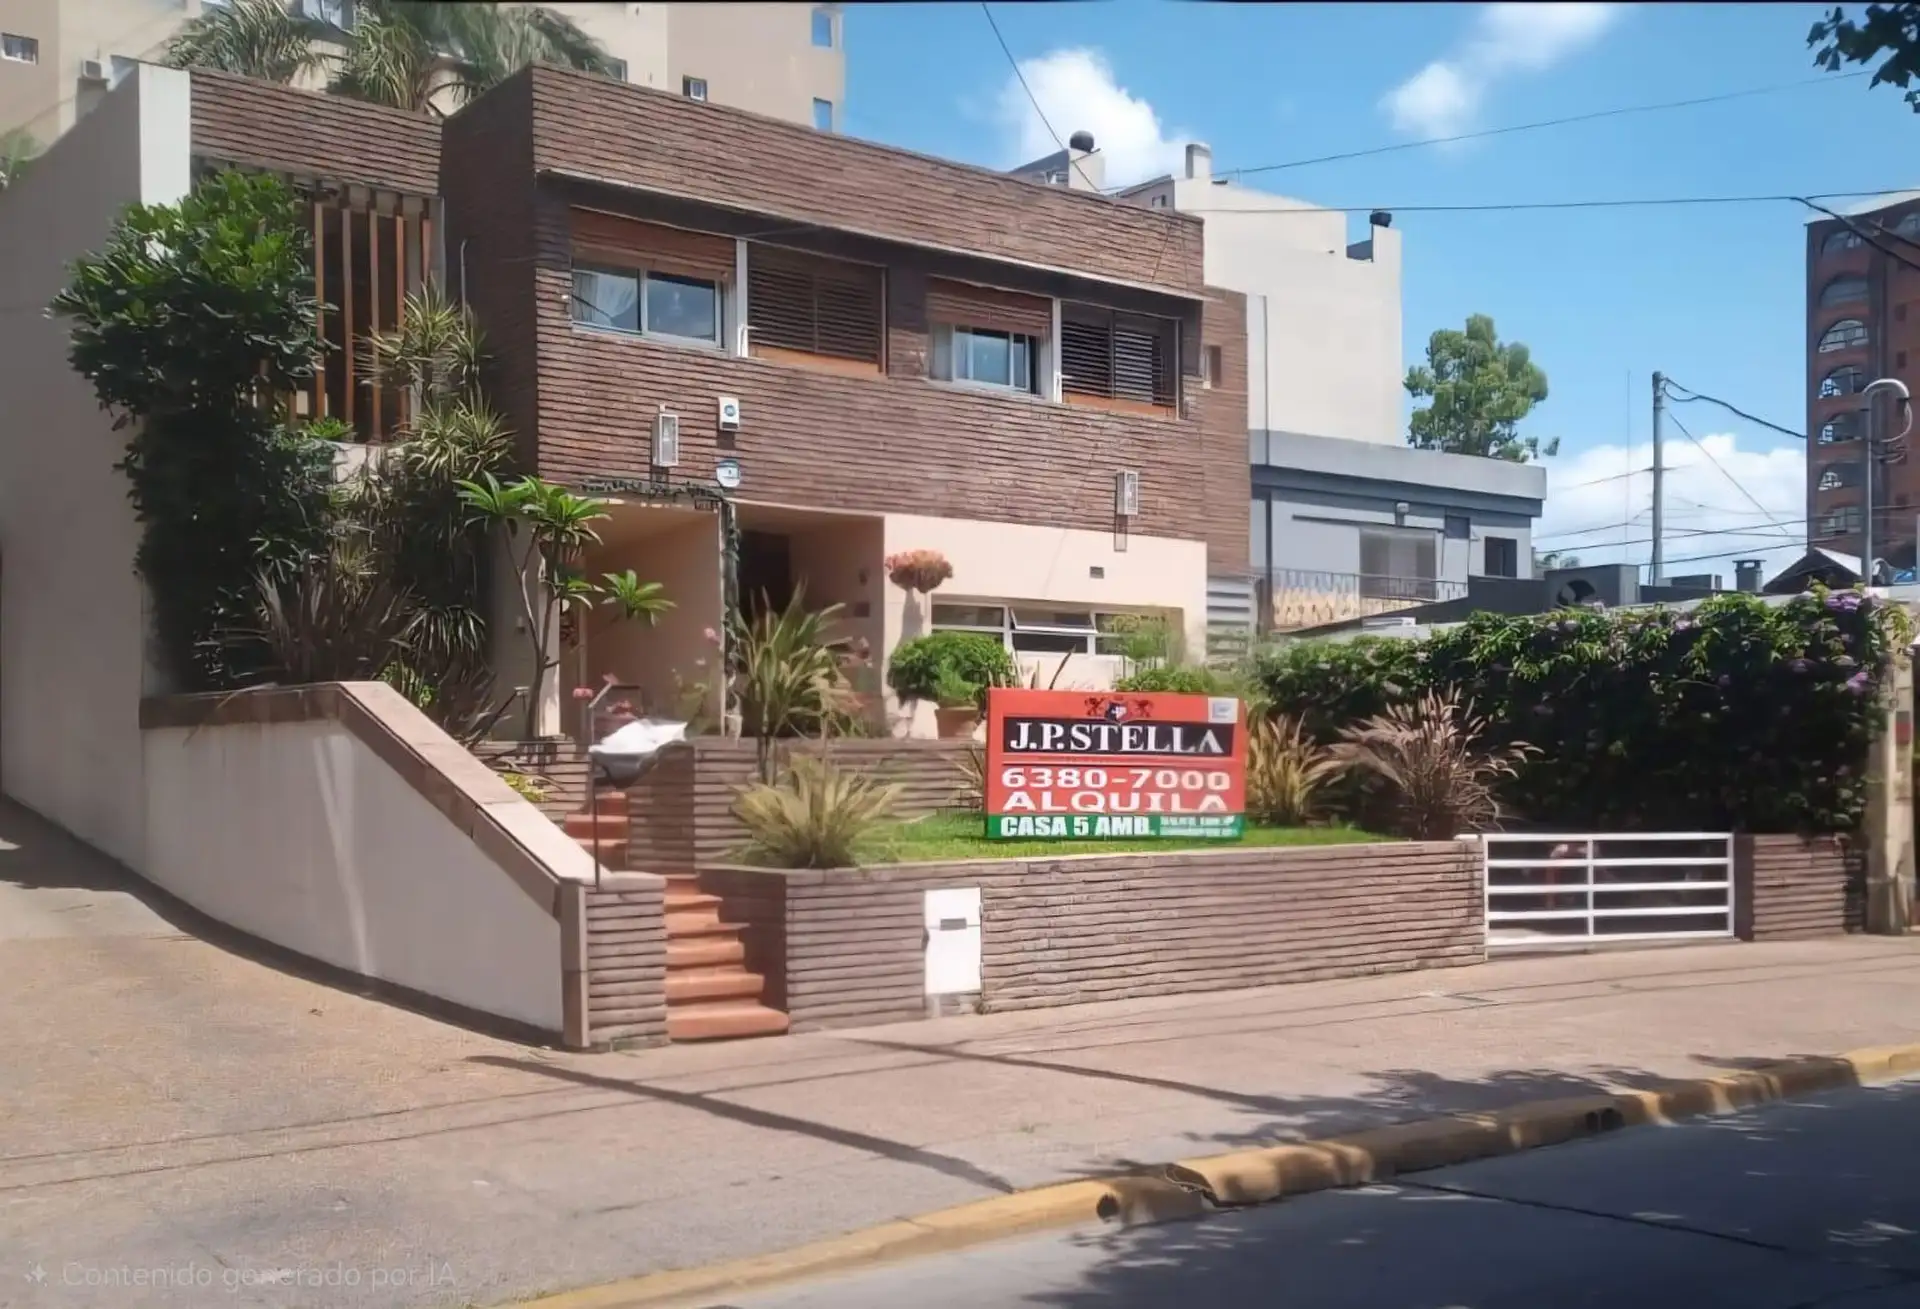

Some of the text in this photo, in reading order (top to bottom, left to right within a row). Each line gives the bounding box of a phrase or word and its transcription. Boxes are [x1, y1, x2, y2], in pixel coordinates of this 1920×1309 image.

[1001, 767, 1231, 790] 6380-7000
[1002, 791, 1229, 812] ALQUILA
[1000, 816, 1068, 836] CASA
[1074, 816, 1089, 836] 5
